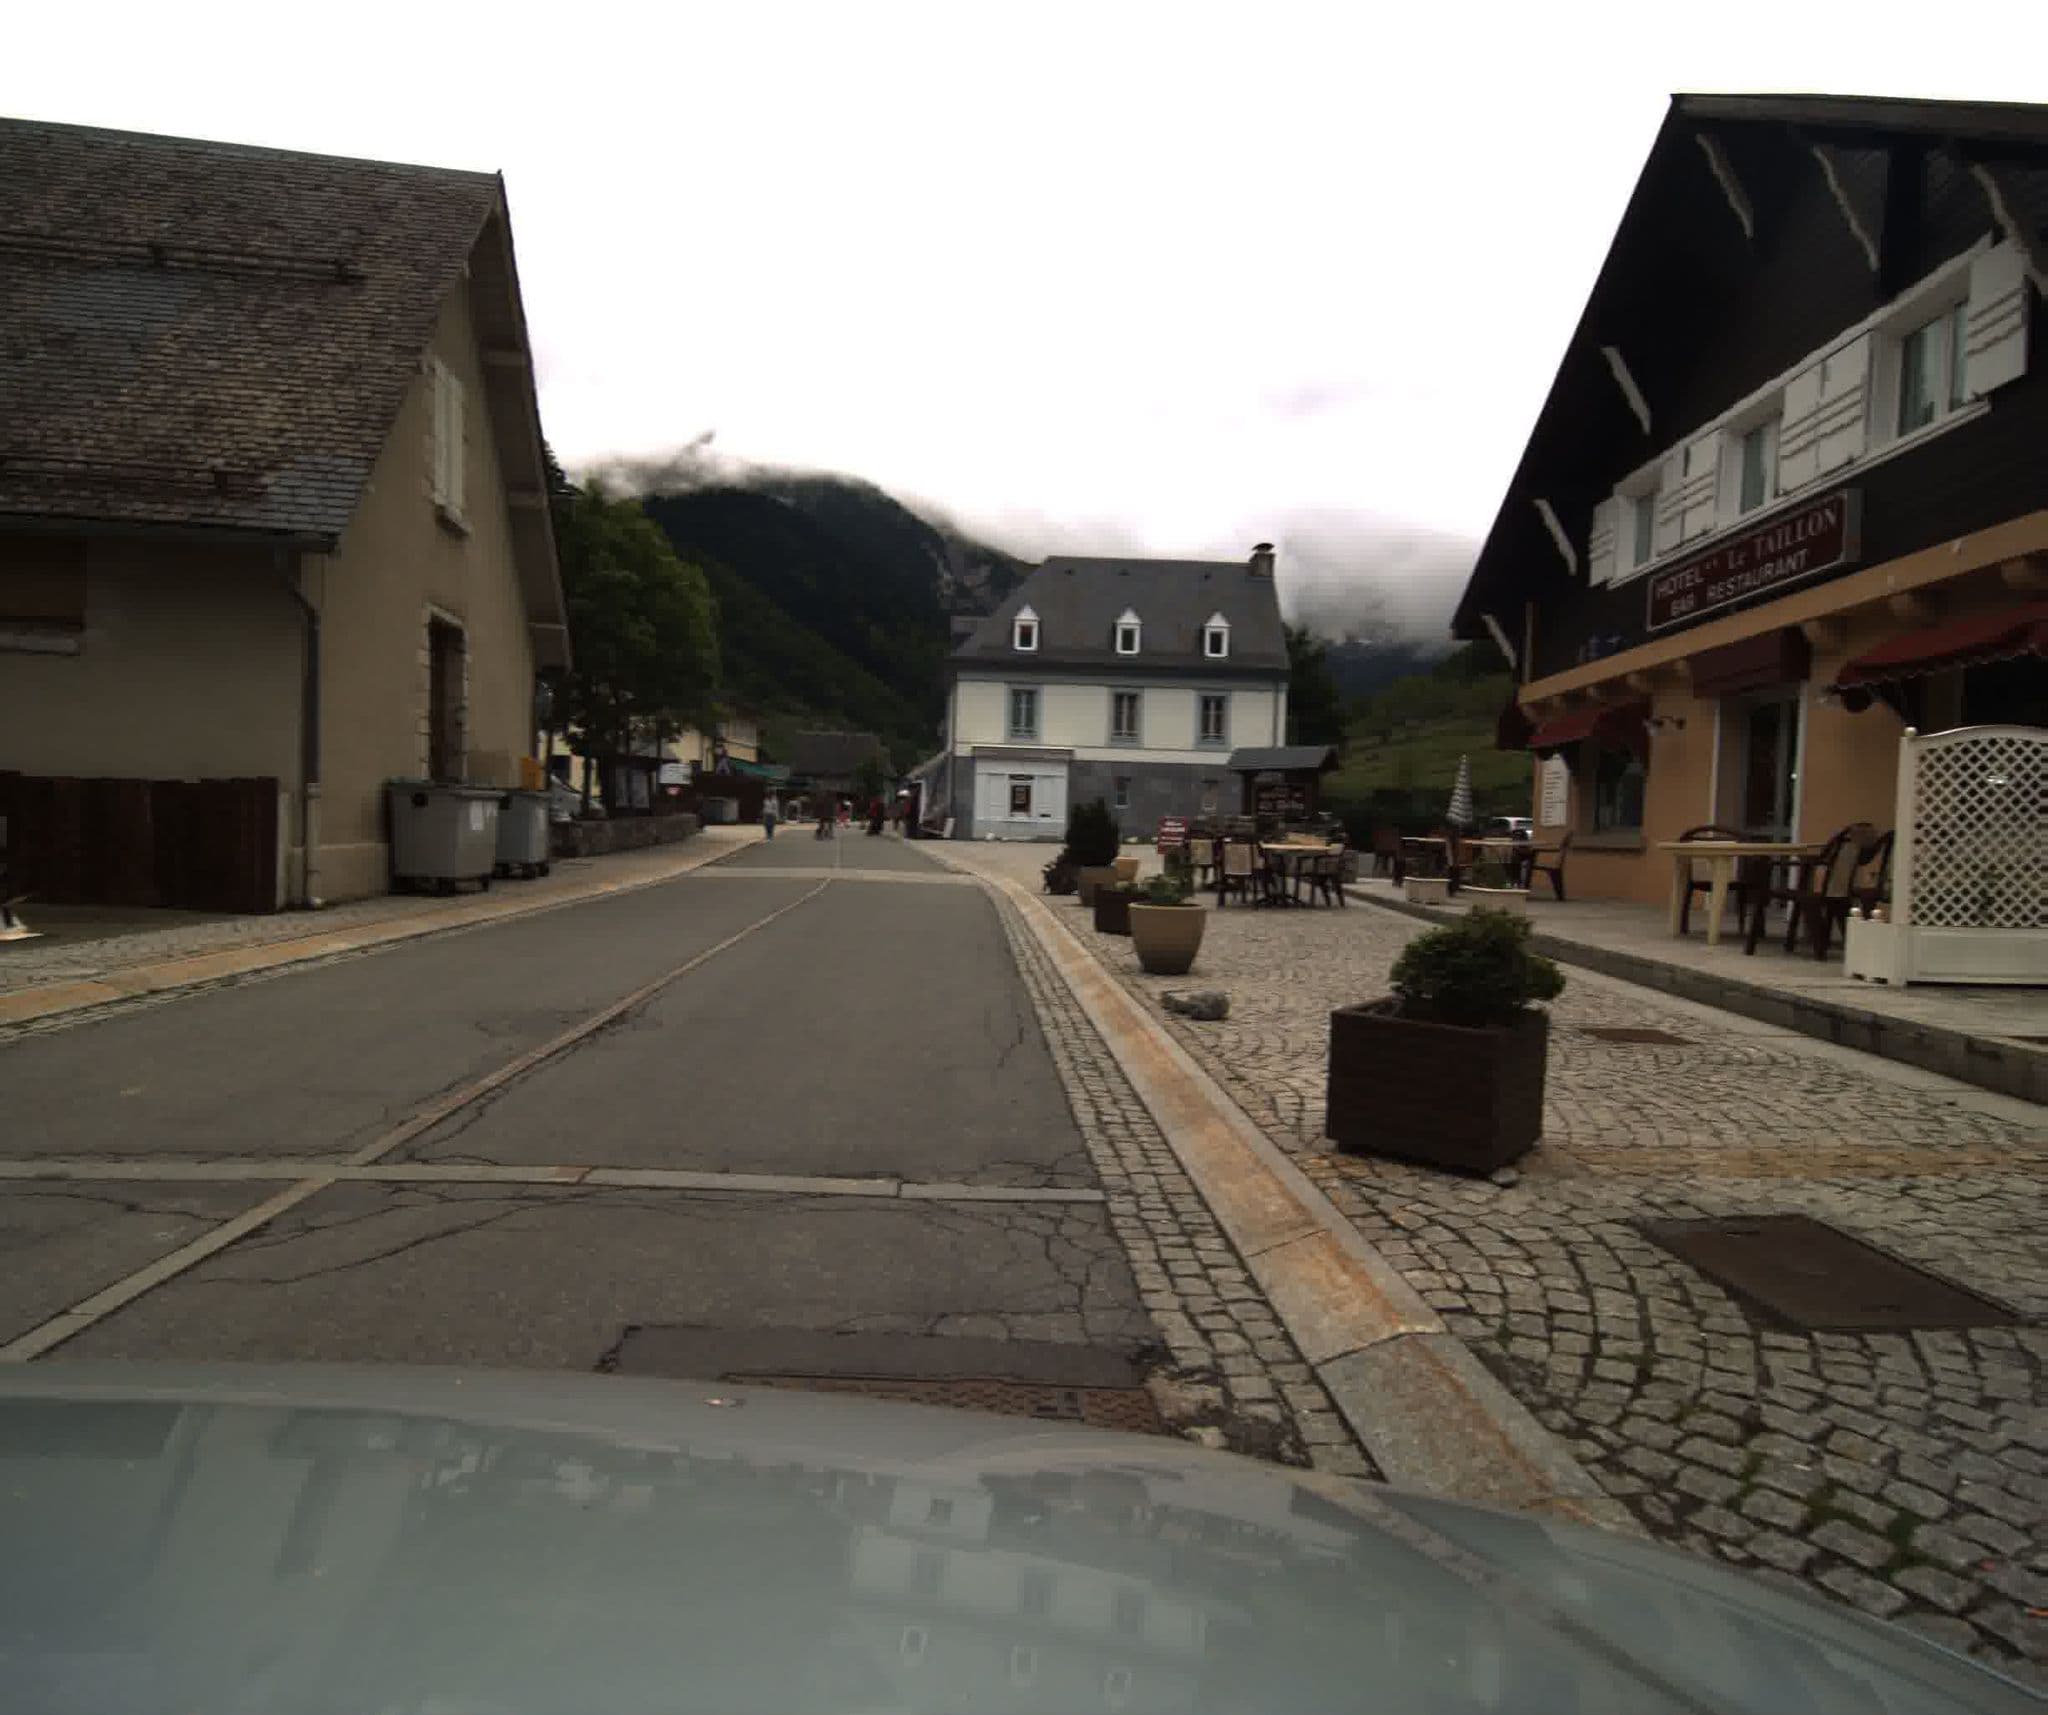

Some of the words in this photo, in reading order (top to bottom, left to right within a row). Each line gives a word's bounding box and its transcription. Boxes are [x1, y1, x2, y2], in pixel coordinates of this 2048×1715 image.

[1655, 566, 1704, 600] HOTEL
[1755, 508, 1840, 560] TAILLON
[1707, 548, 1809, 601] RESTAURANT
